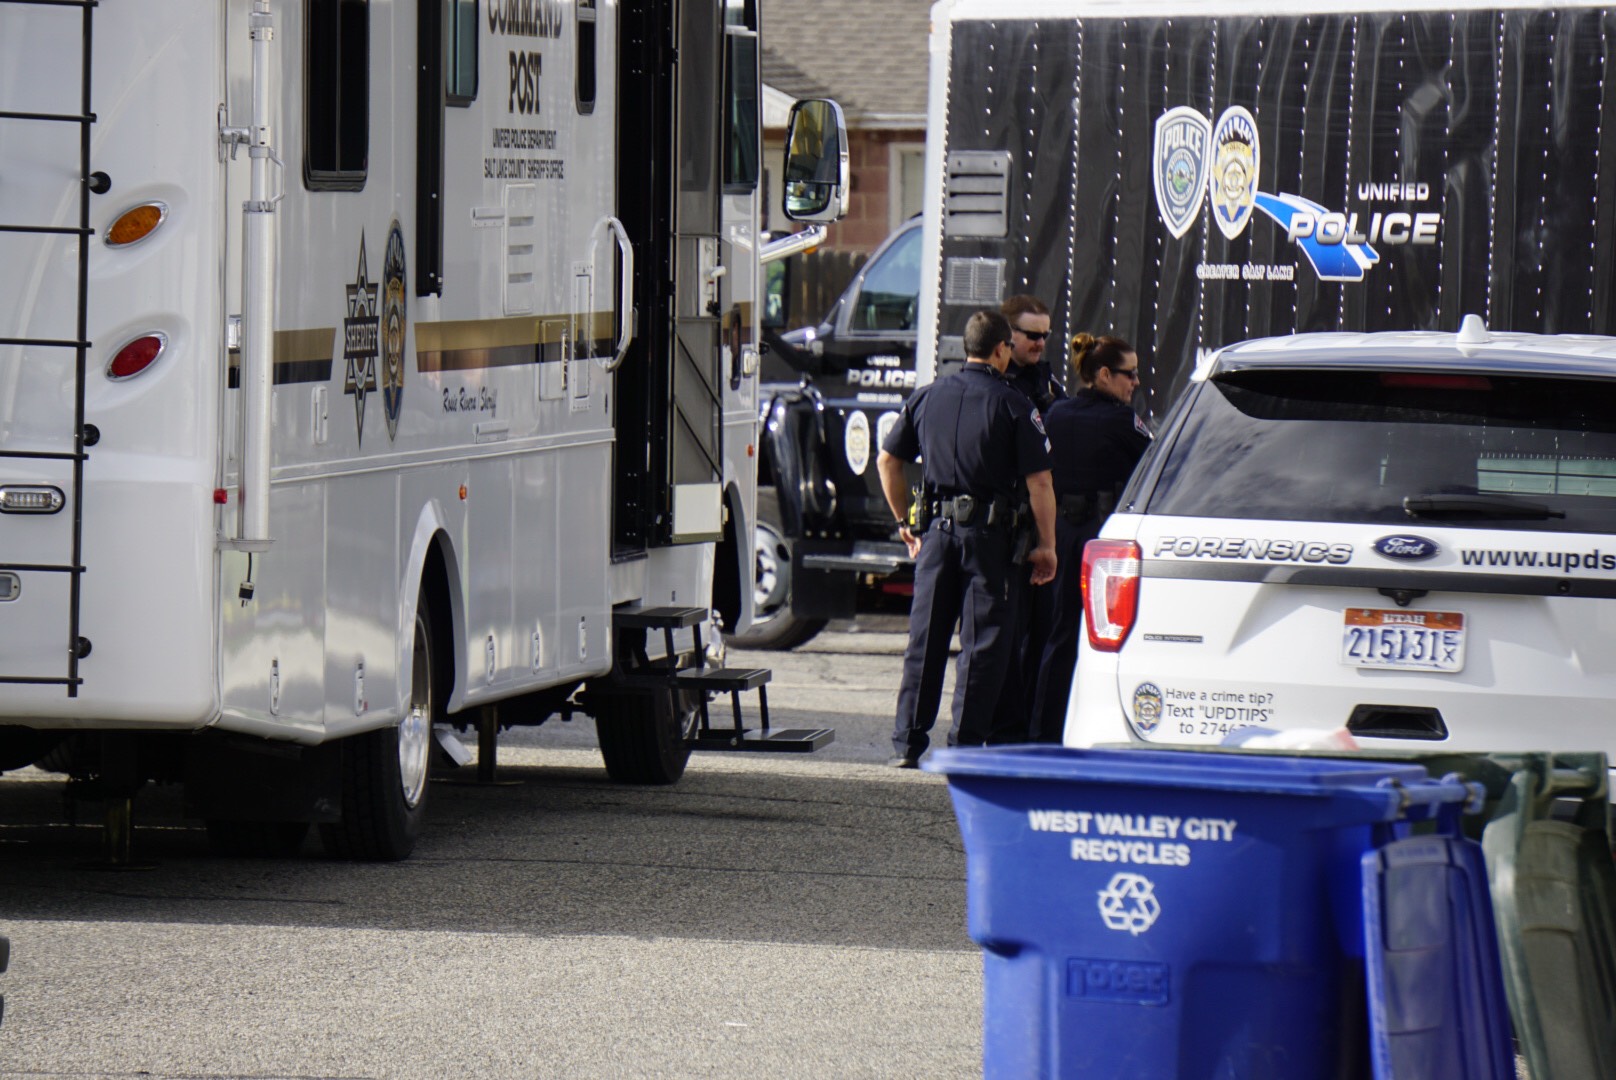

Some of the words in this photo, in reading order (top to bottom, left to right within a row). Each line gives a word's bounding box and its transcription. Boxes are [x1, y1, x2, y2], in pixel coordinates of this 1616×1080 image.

[488, 0, 562, 38] COMMAND
[509, 50, 542, 115] POST
[511, 129, 527, 149] POLICE
[1164, 122, 1202, 160] POLICE
[1358, 183, 1429, 201] UNIFIED
[1287, 212, 1440, 245] POLICE
[1196, 264, 1240, 280] GREATER
[1242, 264, 1265, 280] SALT
[1267, 265, 1294, 281] LAKE
[346, 323, 377, 352] SHERIFF
[847, 369, 917, 388] POLICE
[1153, 536, 1353, 564] FORENSICS
[1383, 537, 1426, 556] Ford
[1461, 549, 1616, 572] www.upds
[1382, 613, 1425, 625] UTAH
[1348, 628, 1439, 660] 215131
[1166, 688, 1196, 699] Have
[1211, 691, 1245, 703] crime
[1249, 693, 1274, 705] tip?
[1166, 704, 1194, 718] Text
[1200, 705, 1274, 722] "UPDTIPS"
[1180, 722, 1194, 734] to
[1028, 810, 1092, 834] WEST
[1095, 813, 1181, 838] VALLEY
[1184, 818, 1237, 841] CITY
[1070, 838, 1190, 866] RECYCLES
